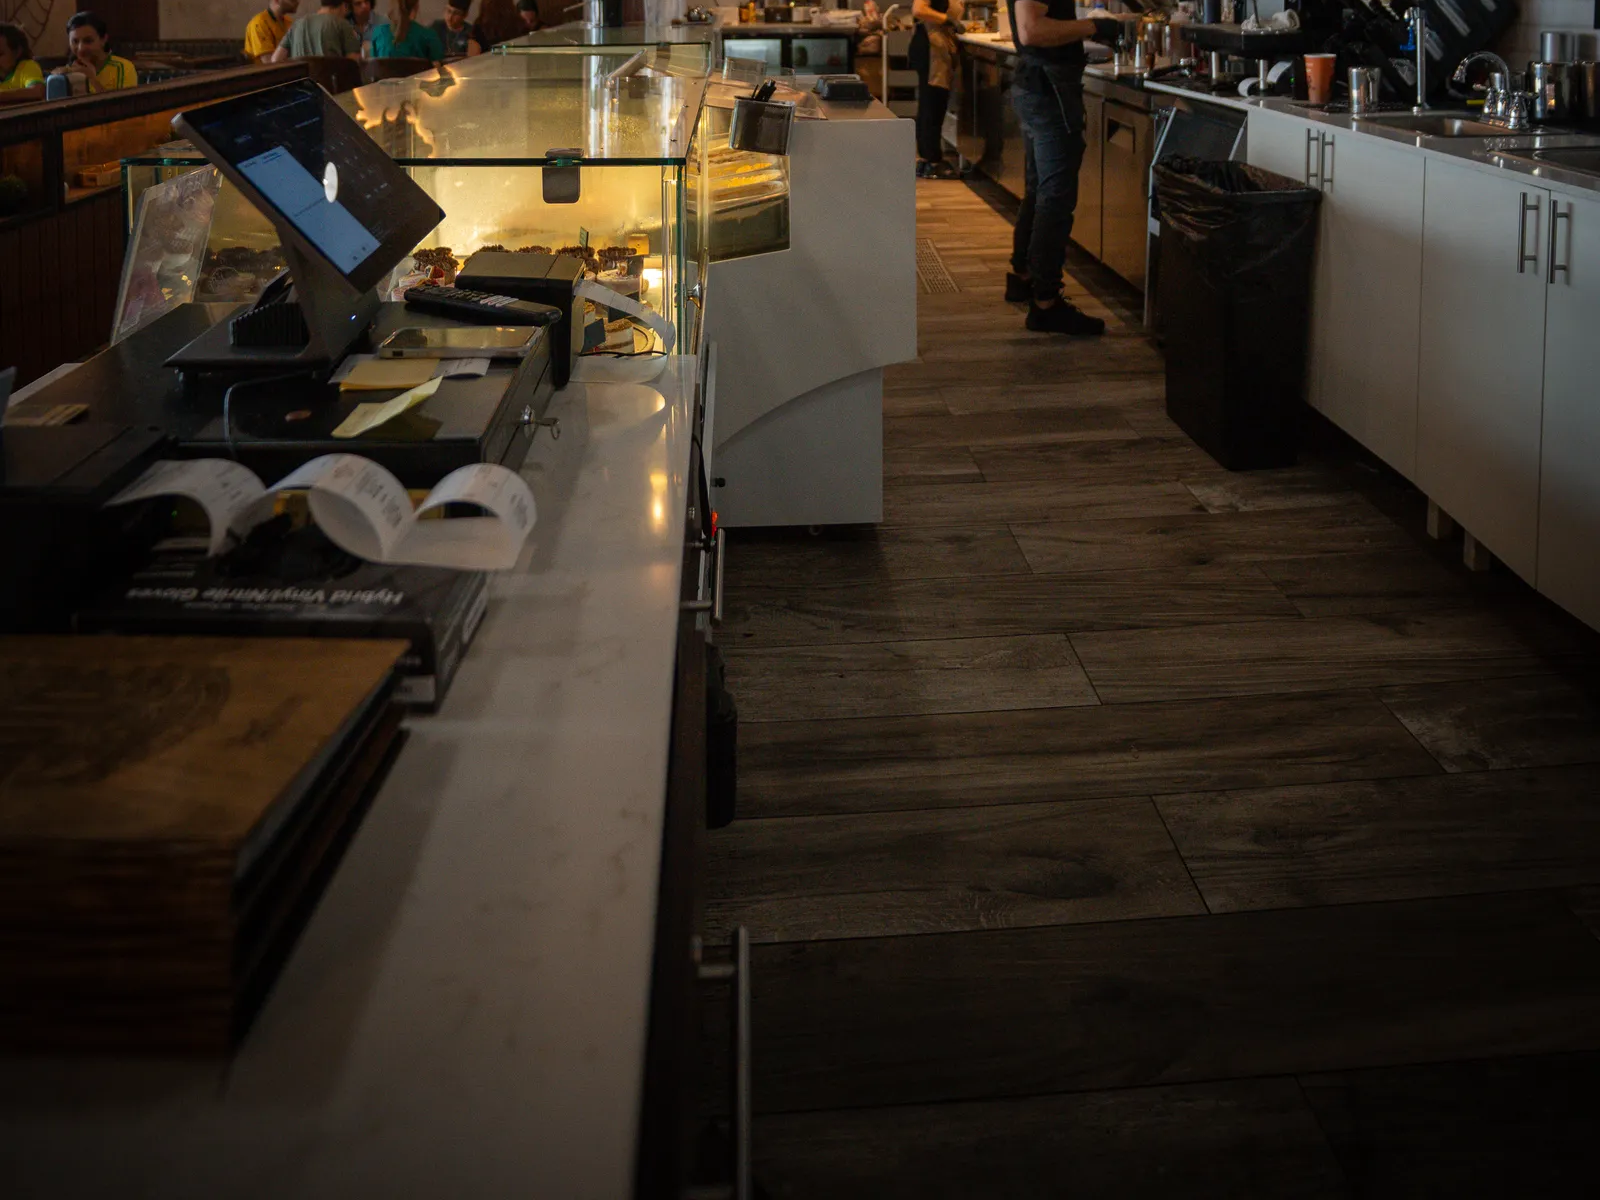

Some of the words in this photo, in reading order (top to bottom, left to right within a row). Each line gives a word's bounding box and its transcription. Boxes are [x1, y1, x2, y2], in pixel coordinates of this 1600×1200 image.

[124, 586, 199, 602] Gloves
[201, 585, 327, 604] Vinyl/Nitrile
[327, 587, 405, 606] Hybrid
